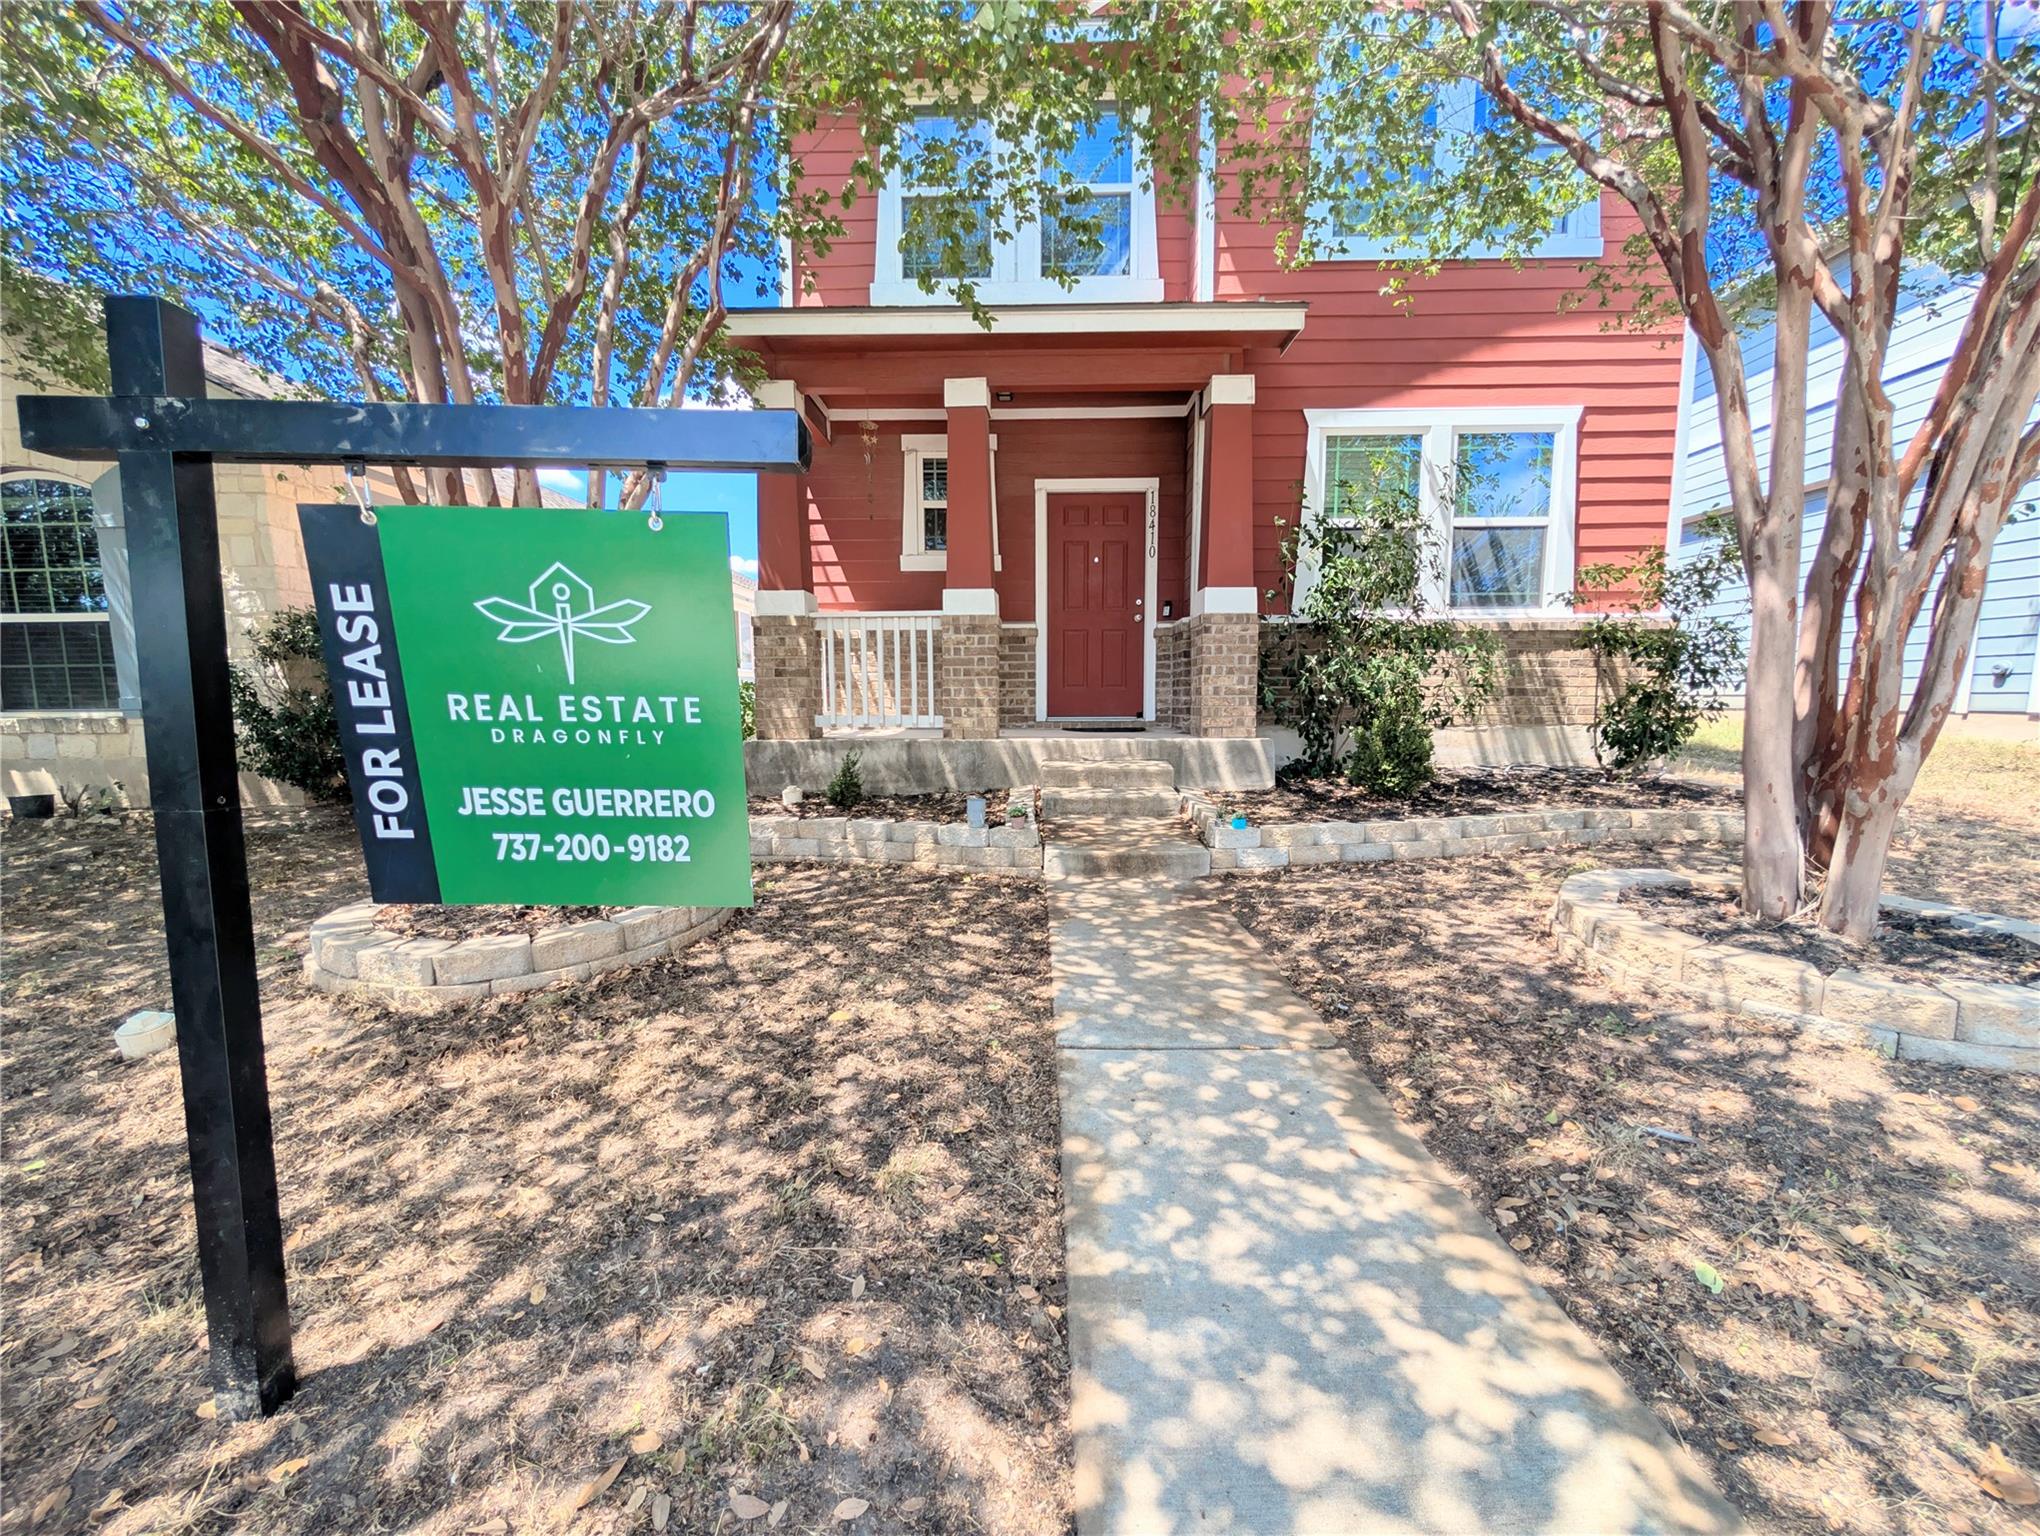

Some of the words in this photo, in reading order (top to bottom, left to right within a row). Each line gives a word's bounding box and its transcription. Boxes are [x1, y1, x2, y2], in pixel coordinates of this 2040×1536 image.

[1148, 490, 1156, 558] 18410
[329, 583, 396, 734] LEASE
[447, 693, 544, 722] REAL
[558, 695, 702, 724] ESTATE
[491, 728, 664, 745] DRAGONFLY
[362, 748, 415, 839] FOR
[457, 787, 547, 816] JESSE
[551, 788, 716, 818] GUERRERO
[492, 832, 692, 863] 737-200-9182
